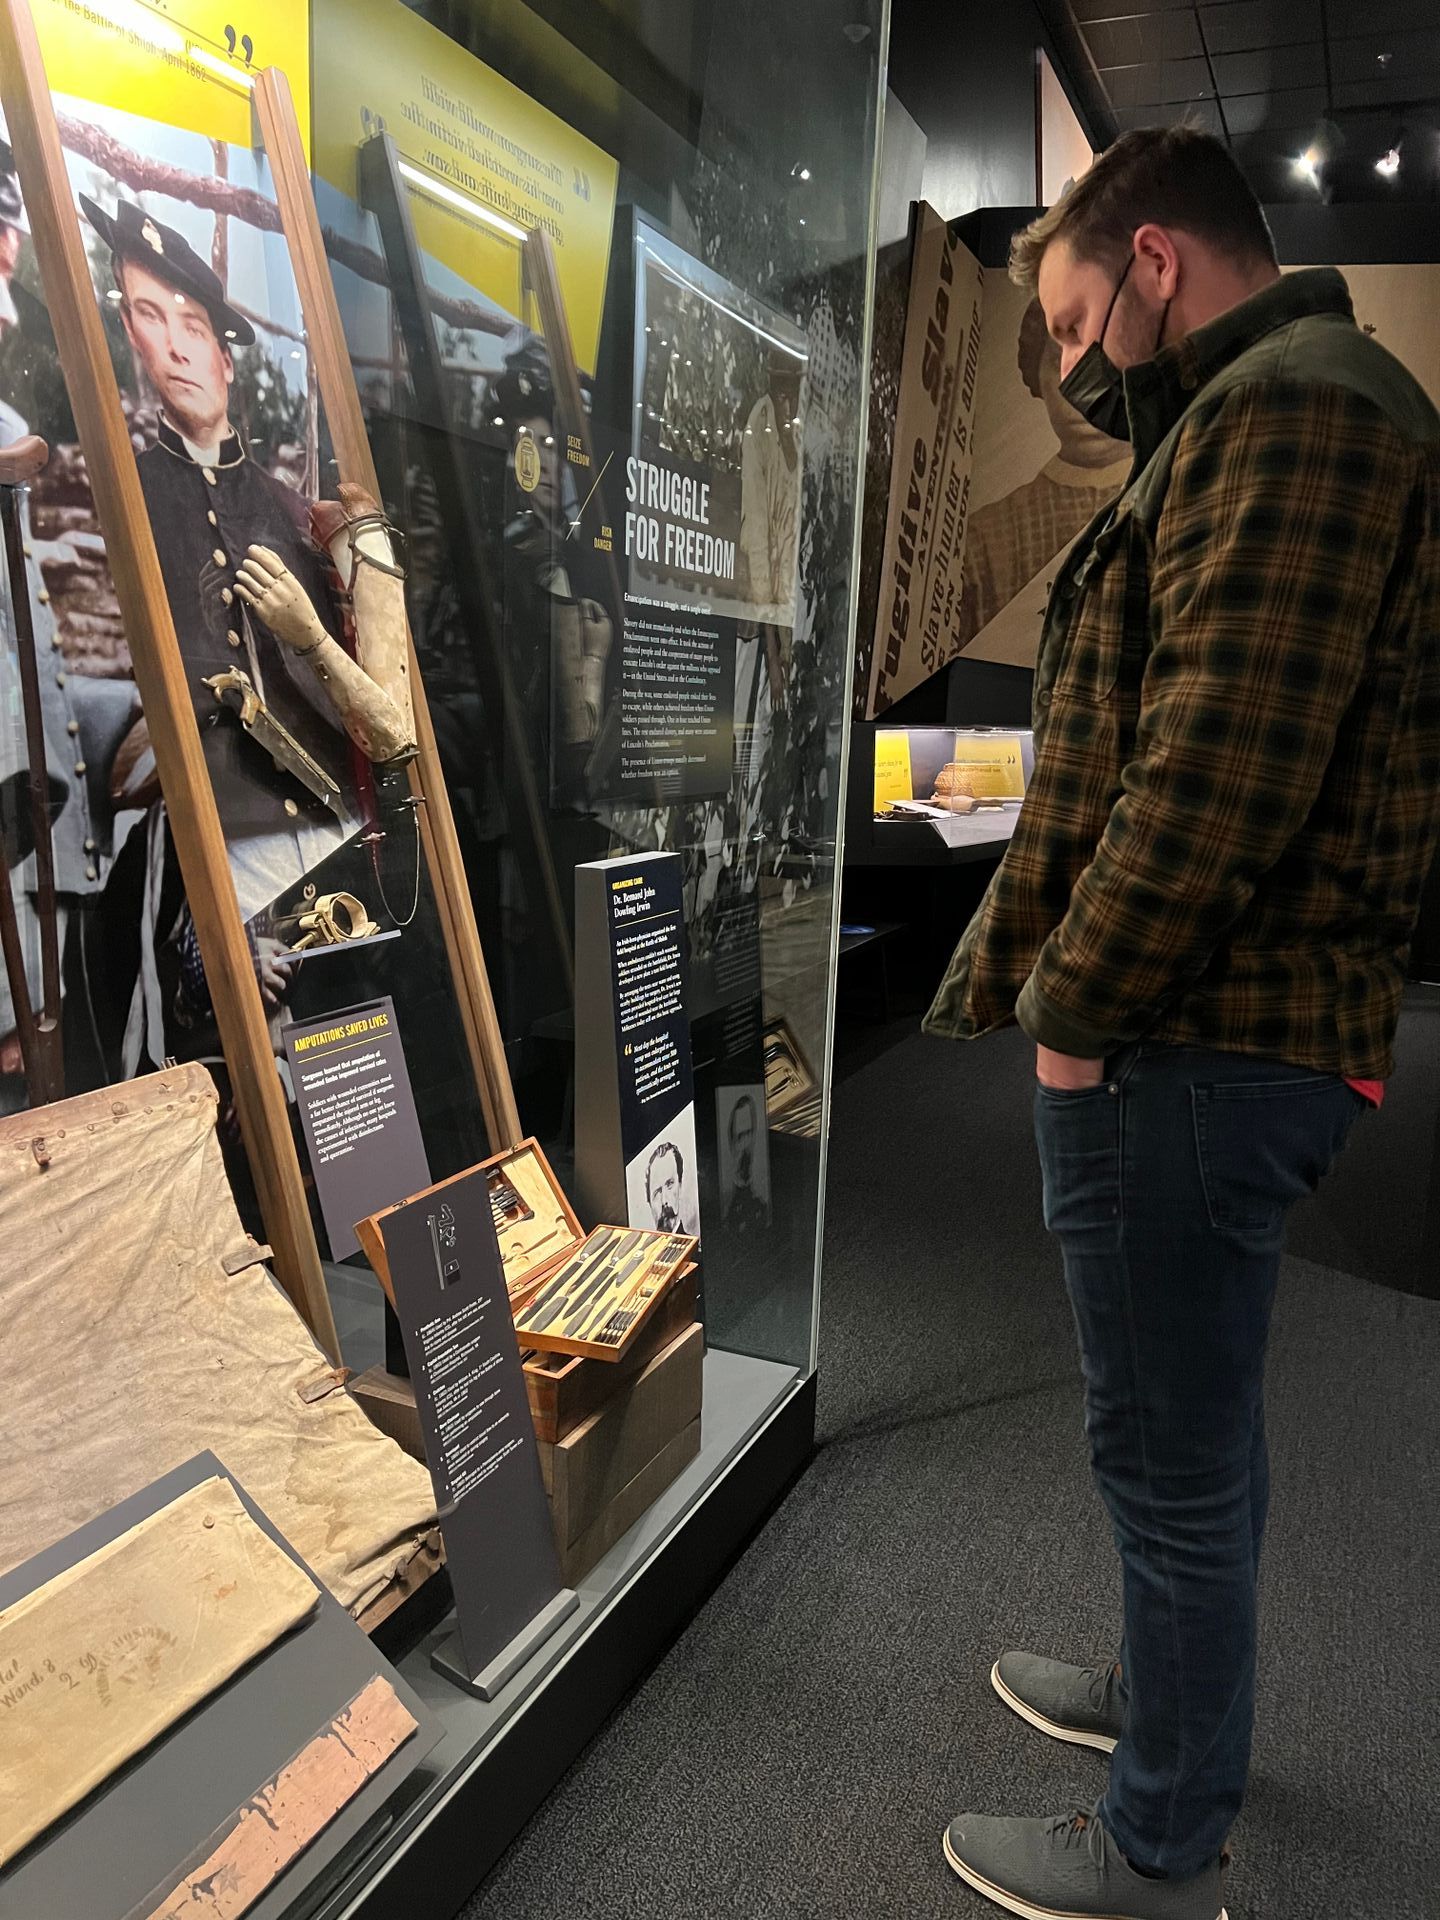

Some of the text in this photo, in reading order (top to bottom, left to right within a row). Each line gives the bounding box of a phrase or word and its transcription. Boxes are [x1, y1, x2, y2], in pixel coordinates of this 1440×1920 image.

[567, 435, 582, 450] SEIZE
[567, 449, 590, 467] FREEDOM
[917, 364, 954, 576] ATTENTION
[625, 456, 710, 525] STRUGGLE
[593, 537, 613, 552] DANGER
[625, 511, 735, 580] FOR FREEDOM
[873, 437, 927, 714] Fugitive
[920, 462, 961, 674] Slave-hunter
[613, 895, 622, 905] Dr.
[644, 887, 655, 900] John
[637, 898, 650, 912] Irwin
[295, 1014, 388, 1051] AMPUTATIONS SAVED LIVES
